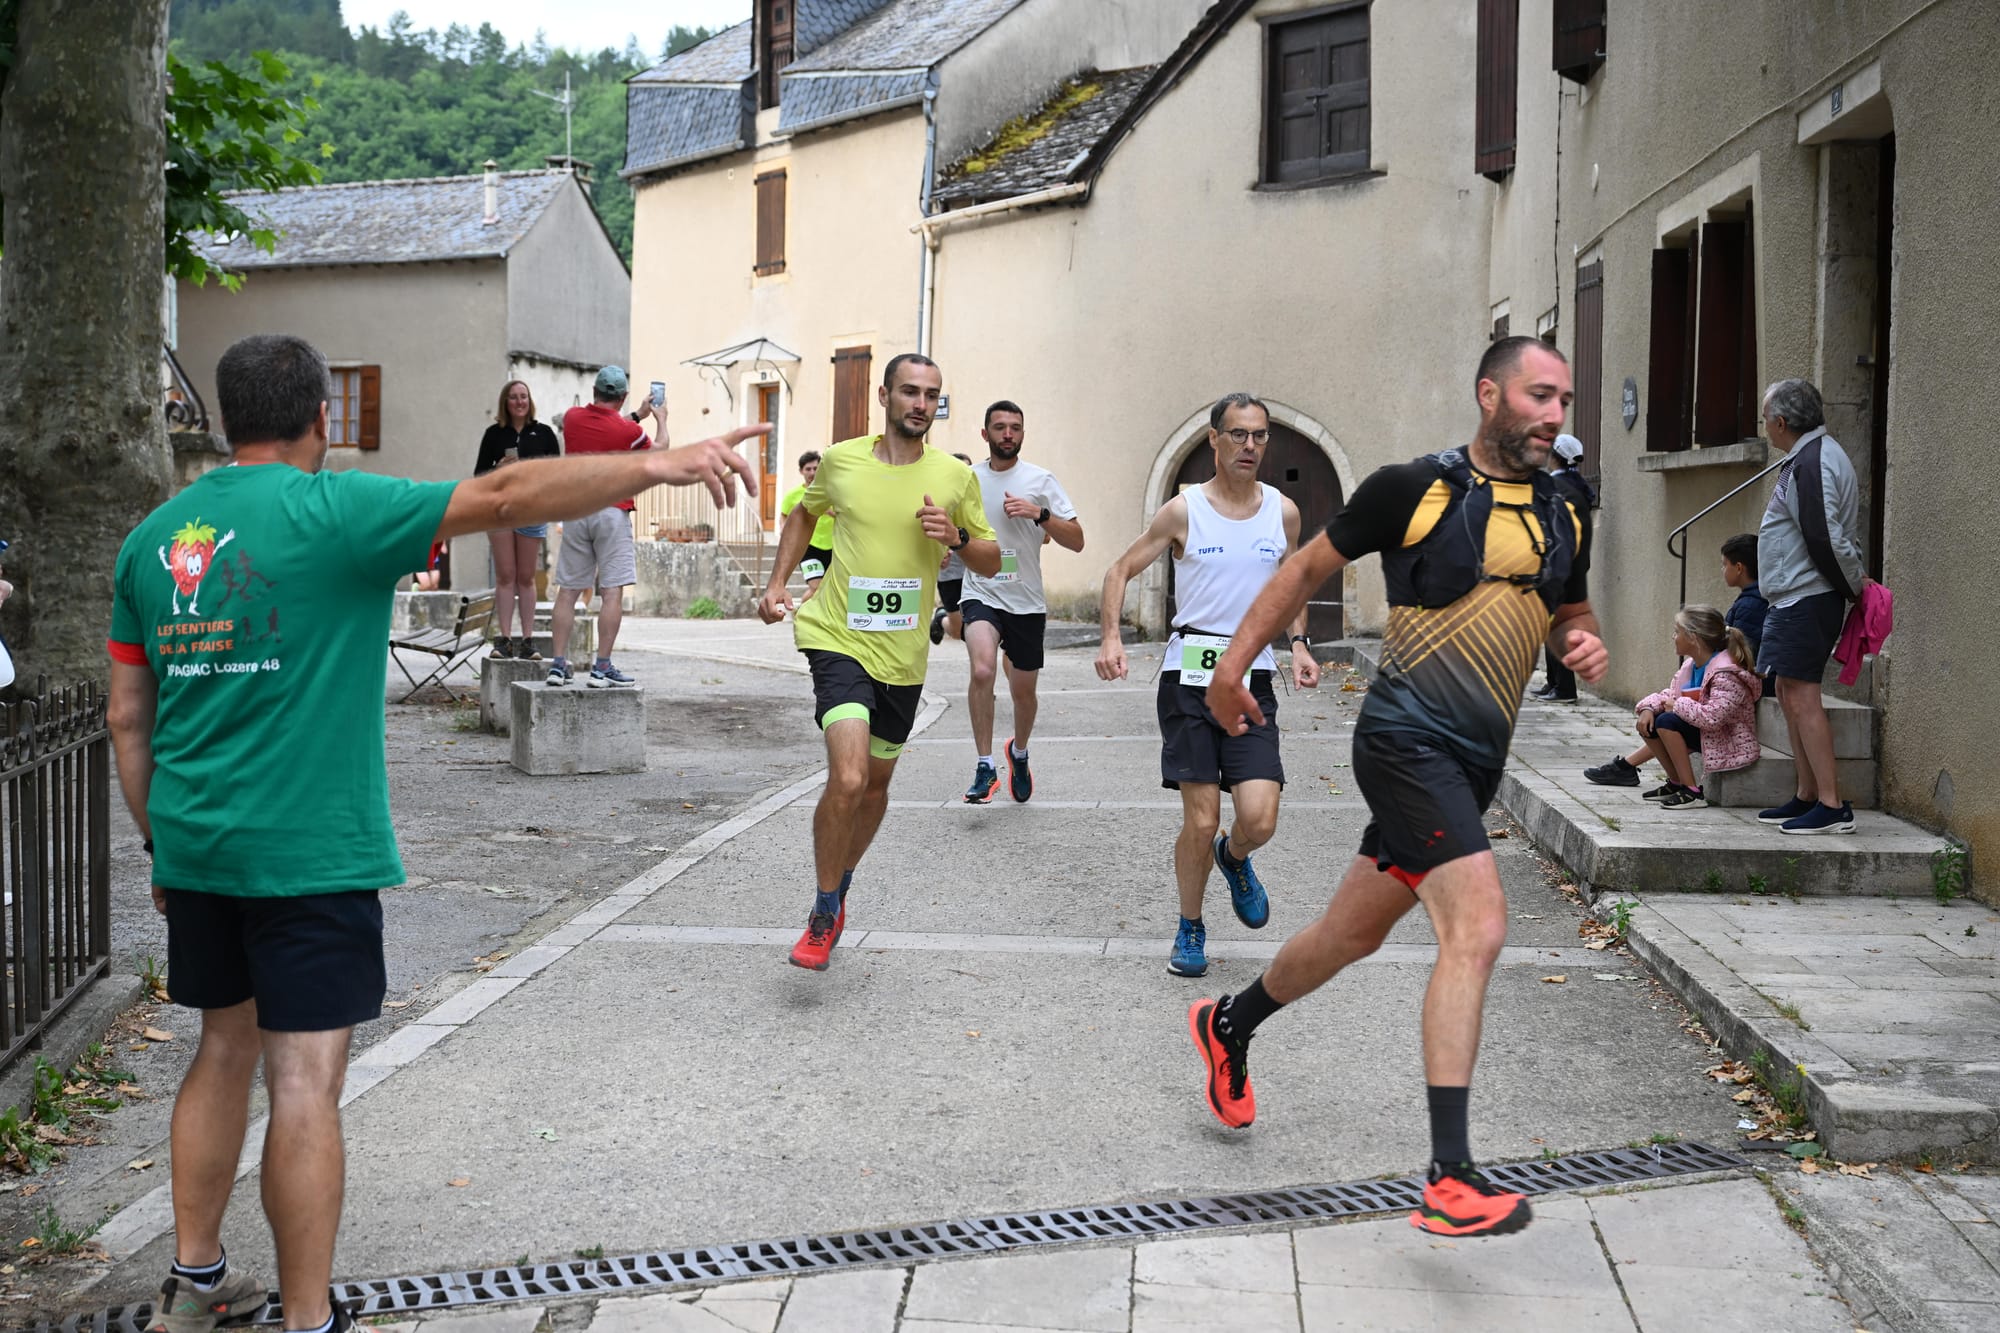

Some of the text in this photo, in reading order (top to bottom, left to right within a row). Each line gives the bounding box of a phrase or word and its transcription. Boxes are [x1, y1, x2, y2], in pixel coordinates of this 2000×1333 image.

[1198, 546, 1224, 555] TUFF'S
[807, 563, 818, 572] 97
[867, 592, 902, 613] 99
[157, 619, 234, 637] LES SENTIERS
[159, 643, 174, 655] DE
[191, 639, 234, 653] FRAISE
[214, 661, 259, 674] Lozere
[261, 658, 281, 672] 48
[1201, 649, 1225, 670] 8
